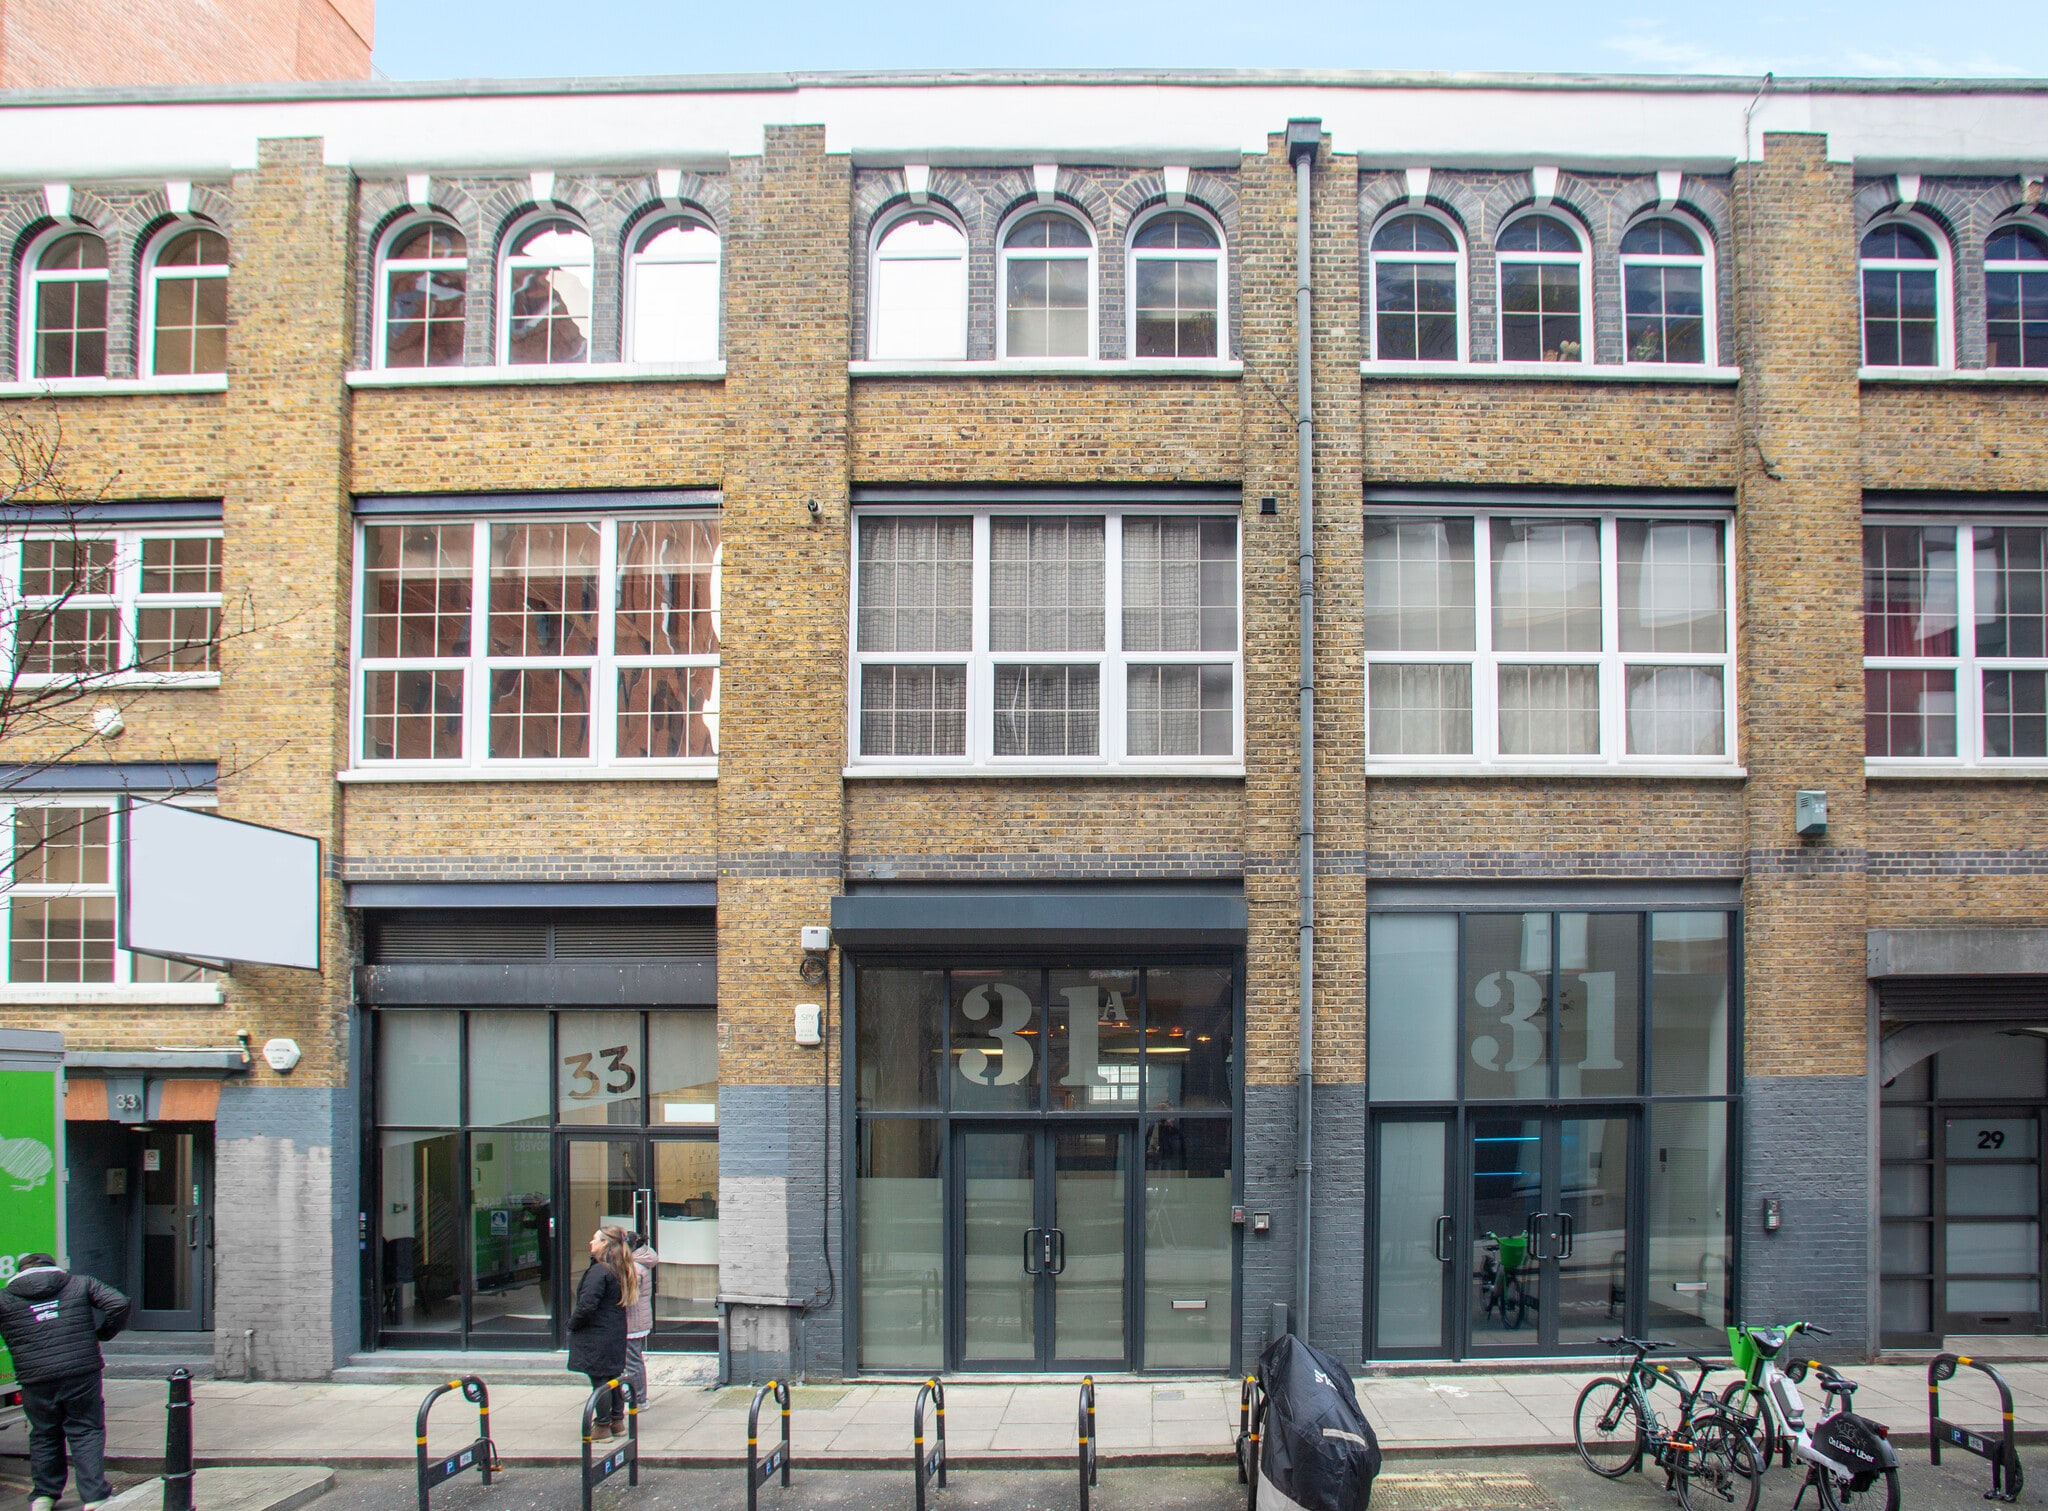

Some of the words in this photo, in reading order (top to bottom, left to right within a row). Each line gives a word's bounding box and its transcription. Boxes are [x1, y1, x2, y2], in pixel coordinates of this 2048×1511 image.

[1470, 970, 1624, 1072] 31
[564, 1045, 636, 1100] 33
[116, 1094, 136, 1109] 33
[1977, 1130, 2005, 1150] 29
[1856, 1449, 1875, 1463] Uber
